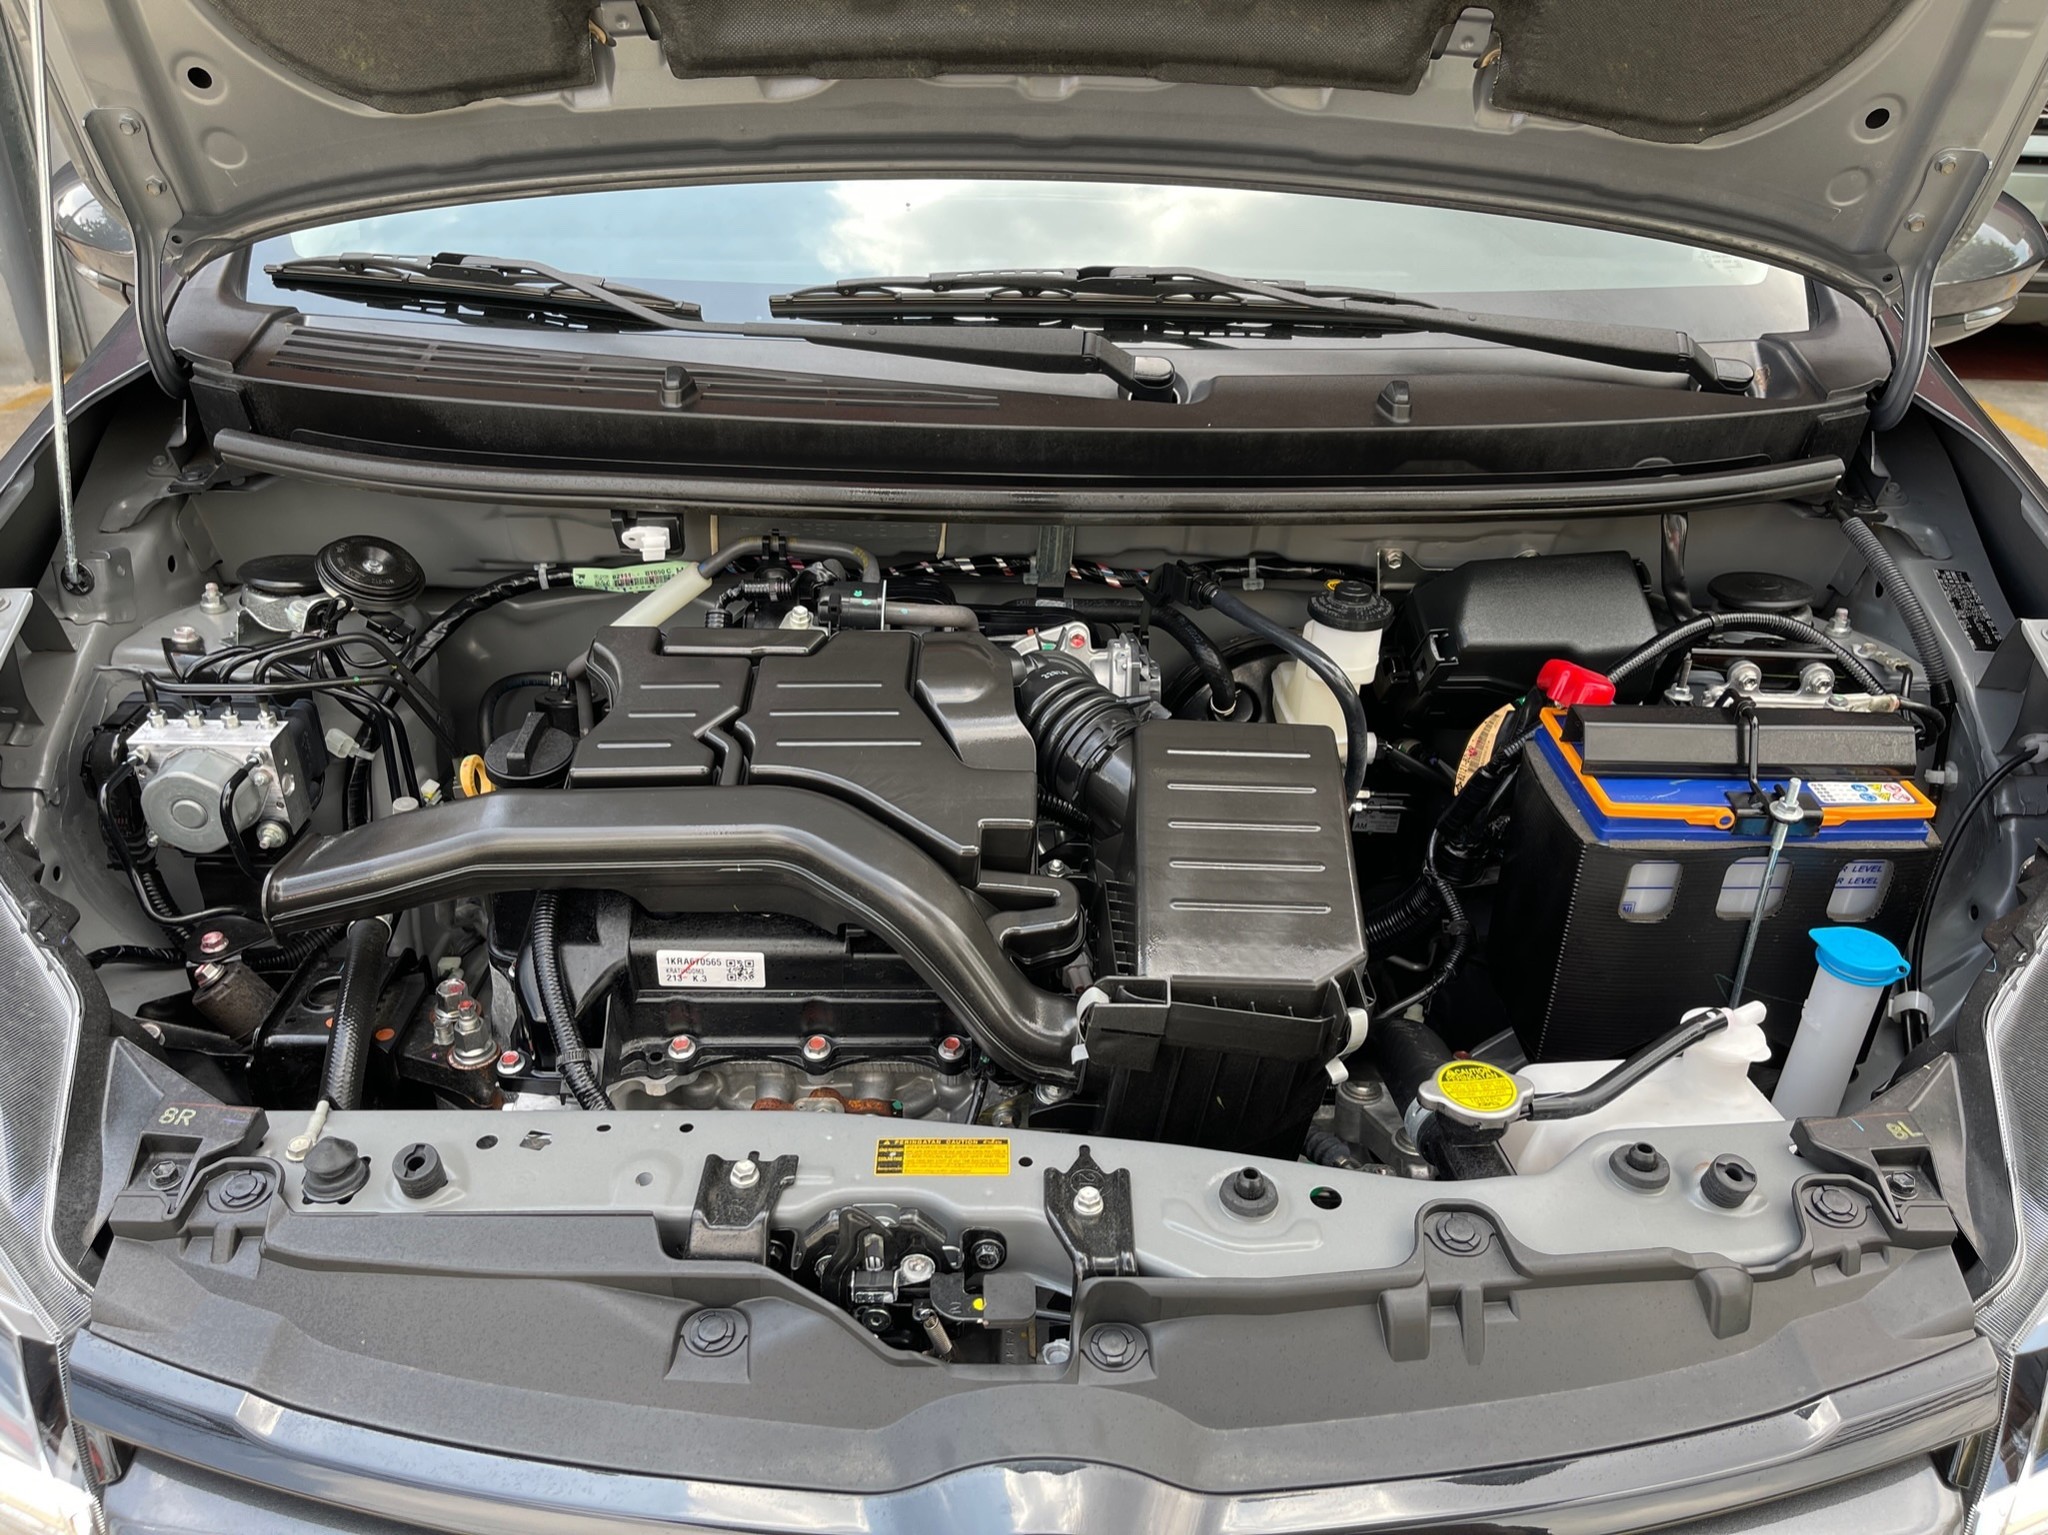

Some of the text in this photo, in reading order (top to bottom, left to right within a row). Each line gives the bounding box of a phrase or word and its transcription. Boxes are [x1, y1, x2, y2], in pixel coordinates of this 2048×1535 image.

[1852, 865, 1883, 873] LEVEL
[1848, 877, 1879, 885] LEVEL
[1454, 1067, 1491, 1075] CAUTION
[158, 1107, 197, 1126] 8R
